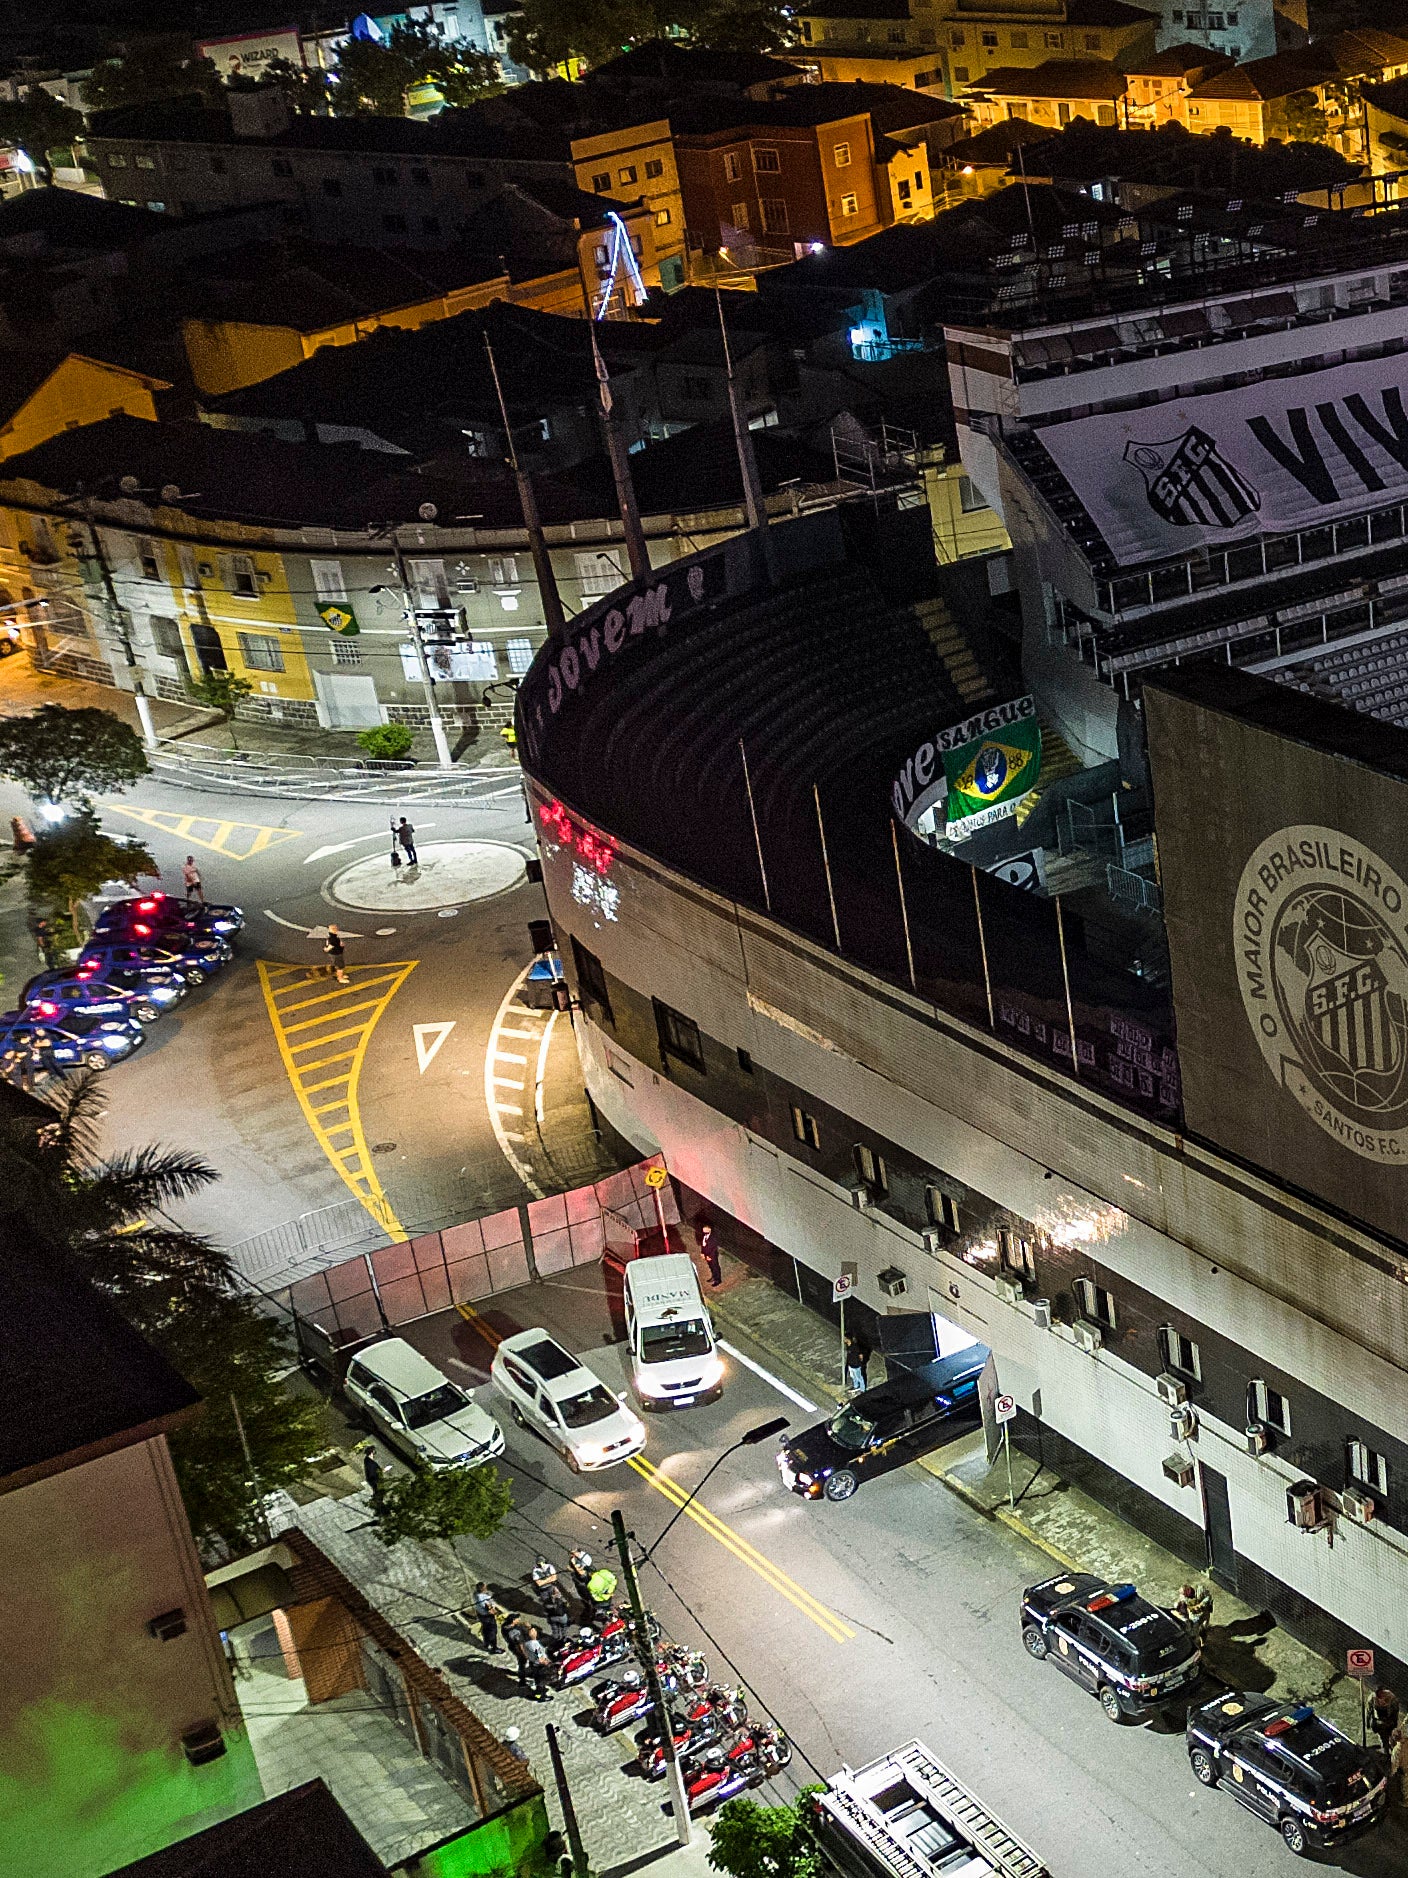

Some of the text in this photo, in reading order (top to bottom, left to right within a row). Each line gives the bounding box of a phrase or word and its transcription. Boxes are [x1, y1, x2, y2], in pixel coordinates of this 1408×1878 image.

[240, 48, 279, 62] WIZARD
[1258, 840, 1402, 914] BRASILEIRO
[1244, 888, 1268, 1000] MAIOR
[1260, 1012, 1277, 1037] O
[1314, 1101, 1376, 1151] SANTOS
